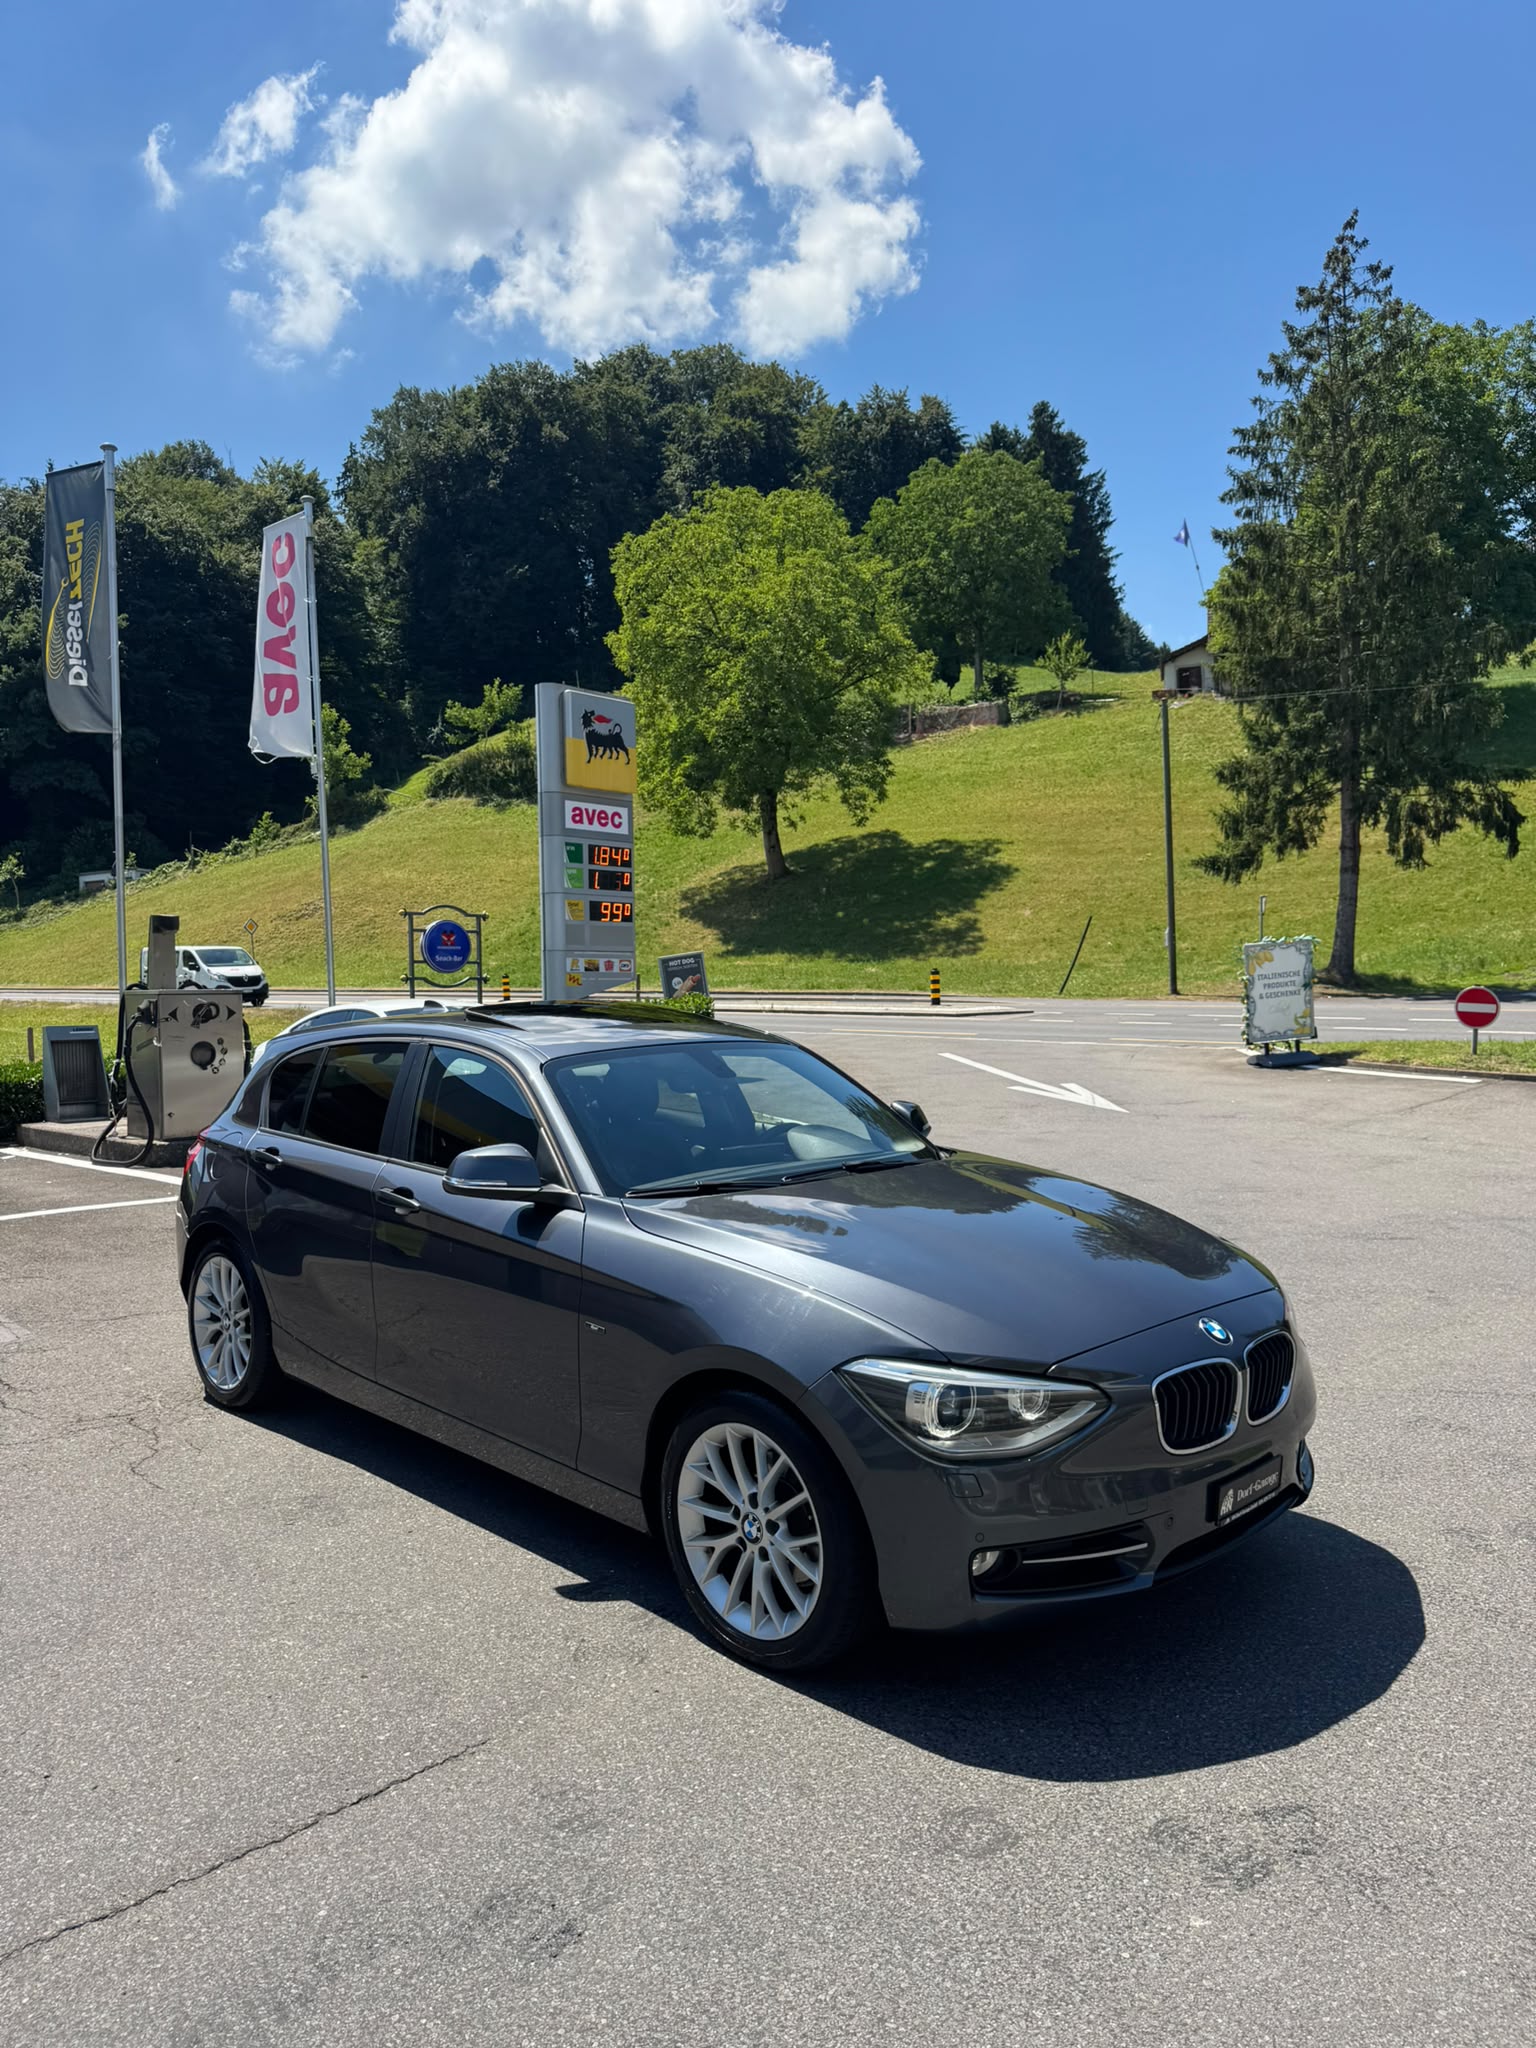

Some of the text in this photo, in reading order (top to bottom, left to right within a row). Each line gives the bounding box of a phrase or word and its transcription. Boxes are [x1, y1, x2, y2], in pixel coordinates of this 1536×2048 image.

[571, 804, 623, 830] avec
[682, 957, 695, 965] DOG
[1257, 970, 1301, 981] ITALIENISCHE
[1263, 980, 1297, 990] PRODUKTE
[1265, 989, 1301, 999] GESCHENKE
